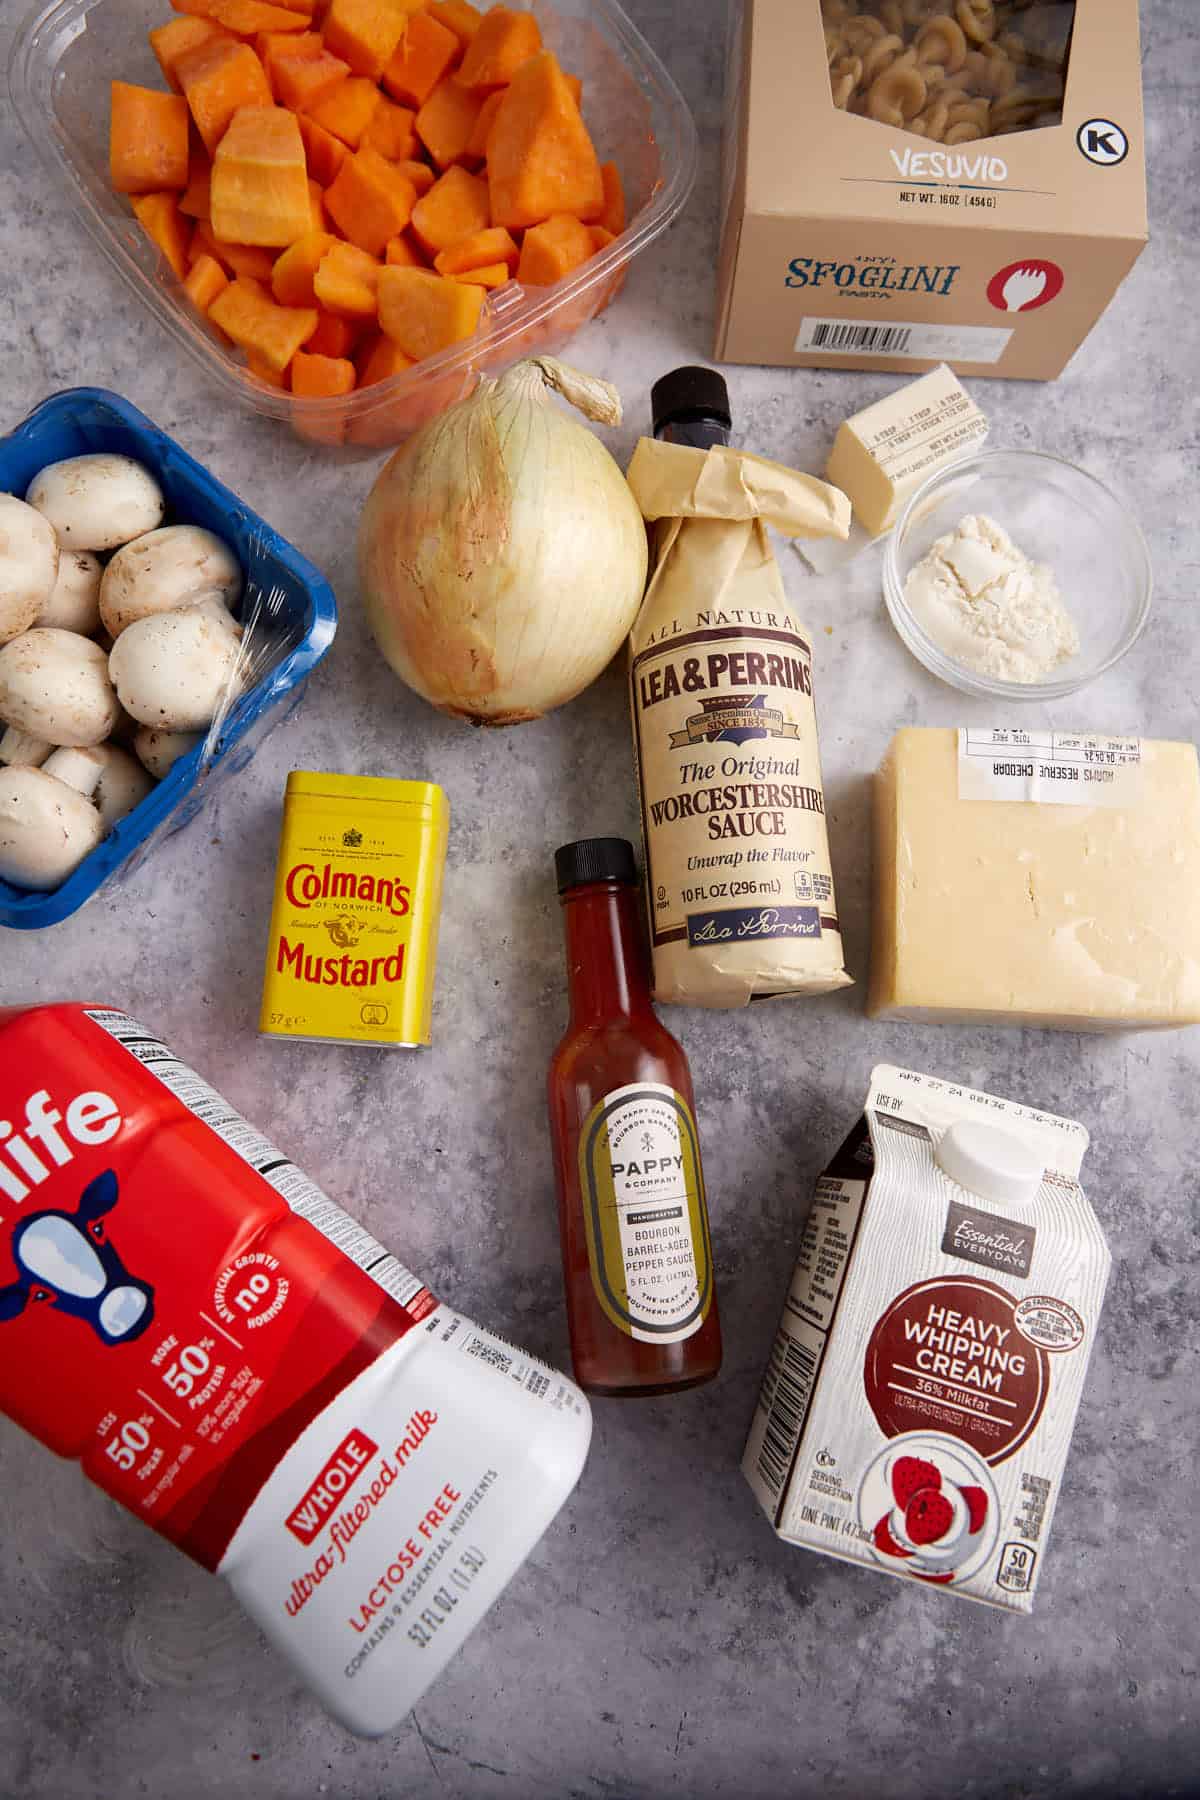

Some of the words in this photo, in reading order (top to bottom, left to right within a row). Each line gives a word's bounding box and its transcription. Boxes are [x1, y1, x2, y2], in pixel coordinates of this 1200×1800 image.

[889, 147, 1009, 182] VESUVIO
[899, 191, 917, 203] NET
[919, 193, 937, 204] WT.
[939, 194, 960, 206] 16OZ
[784, 257, 961, 296] SFOGLINI
[838, 289, 892, 299] PASTA
[647, 620, 682, 646] ALL
[707, 718, 740, 731] SINCE
[712, 709, 752, 721] Premium
[753, 708, 782, 723] Quality
[680, 763, 716, 785] The
[721, 757, 800, 780] Original
[992, 763, 1034, 777] CHEDDAR
[1039, 765, 1080, 781] RESERVE
[708, 811, 787, 841] SAUCE
[687, 851, 743, 871] Unwrap
[747, 848, 769, 863] the
[285, 863, 411, 917] Colman's
[681, 888, 693, 903] 10
[694, 886, 708, 901] FL
[709, 884, 729, 898] OZ
[730, 880, 757, 898] (296
[759, 878, 782, 895] mL)
[315, 902, 328, 910] OF
[333, 902, 383, 913] NORWICH
[694, 919, 732, 942] Lea
[276, 935, 406, 988] Mustard
[876, 1092, 890, 1107] USE
[890, 1097, 904, 1111] BY
[610, 1154, 684, 1179] PAPPY
[634, 1225, 681, 1241] BOURBON
[953, 1219, 1026, 1256] Essential
[626, 1238, 690, 1257] BARREL-AGED
[625, 1257, 664, 1273] PEPPER
[666, 1251, 694, 1267] SAUCE
[213, 1267, 237, 1324] ARTIFICIAL
[235, 1252, 280, 1271] GROWTH
[234, 1273, 270, 1312] no
[641, 1291, 657, 1303] THE
[659, 1293, 679, 1304] HEAT
[927, 1303, 1011, 1346] HEAVY
[151, 1334, 179, 1367] MORE
[903, 1317, 1026, 1376] WHIPPING
[161, 1335, 216, 1398] 50%
[915, 1348, 1003, 1393] CREAM
[187, 1365, 226, 1410] PROTEIN
[915, 1377, 944, 1396] 36%
[946, 1388, 991, 1413] Milkfat
[96, 1410, 118, 1437] LESS
[105, 1412, 155, 1471] 50%
[290, 1438, 369, 1533] WHOLE
[808, 1479, 854, 1502] SUGGESTION
[811, 1469, 843, 1487] SERVING
[284, 1459, 400, 1617] ultra-filtered
[394, 1408, 438, 1468] milk
[800, 1505, 818, 1526] ONE
[819, 1510, 841, 1531] PINT
[349, 1538, 424, 1633] LACTOSE
[417, 1482, 462, 1540] FREE
[1010, 1549, 1027, 1567] 50
[344, 1615, 396, 1680] CONTAINS
[392, 1605, 402, 1617] 9
[399, 1538, 452, 1608] ESSENTIAL
[449, 1468, 499, 1536] NUTRIENTS
[433, 1585, 459, 1615] OZ
[423, 1605, 445, 1633] FL
[407, 1624, 433, 1649] 52
